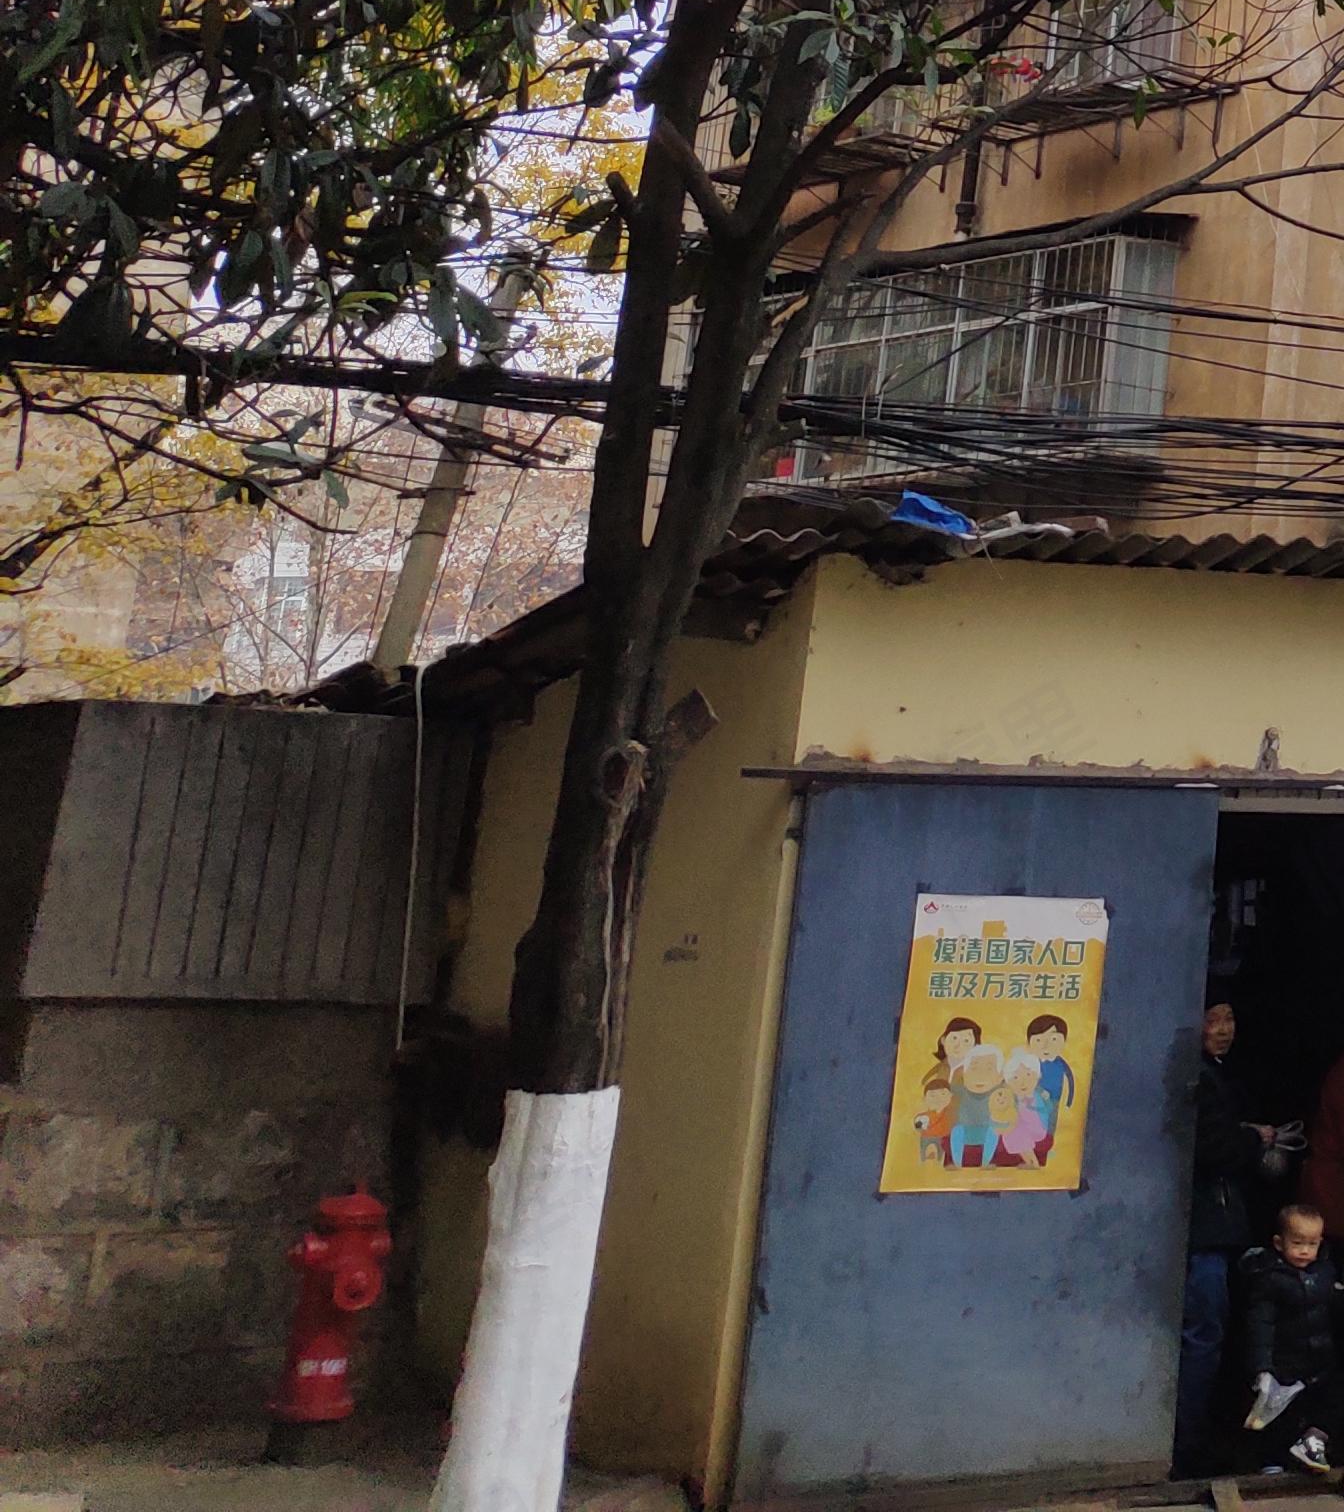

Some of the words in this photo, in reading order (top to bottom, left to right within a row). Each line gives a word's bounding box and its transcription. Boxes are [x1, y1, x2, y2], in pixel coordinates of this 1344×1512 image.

[933, 937, 1086, 966] 摸清国家人口
[927, 971, 1083, 1000] 惠及万家生活
